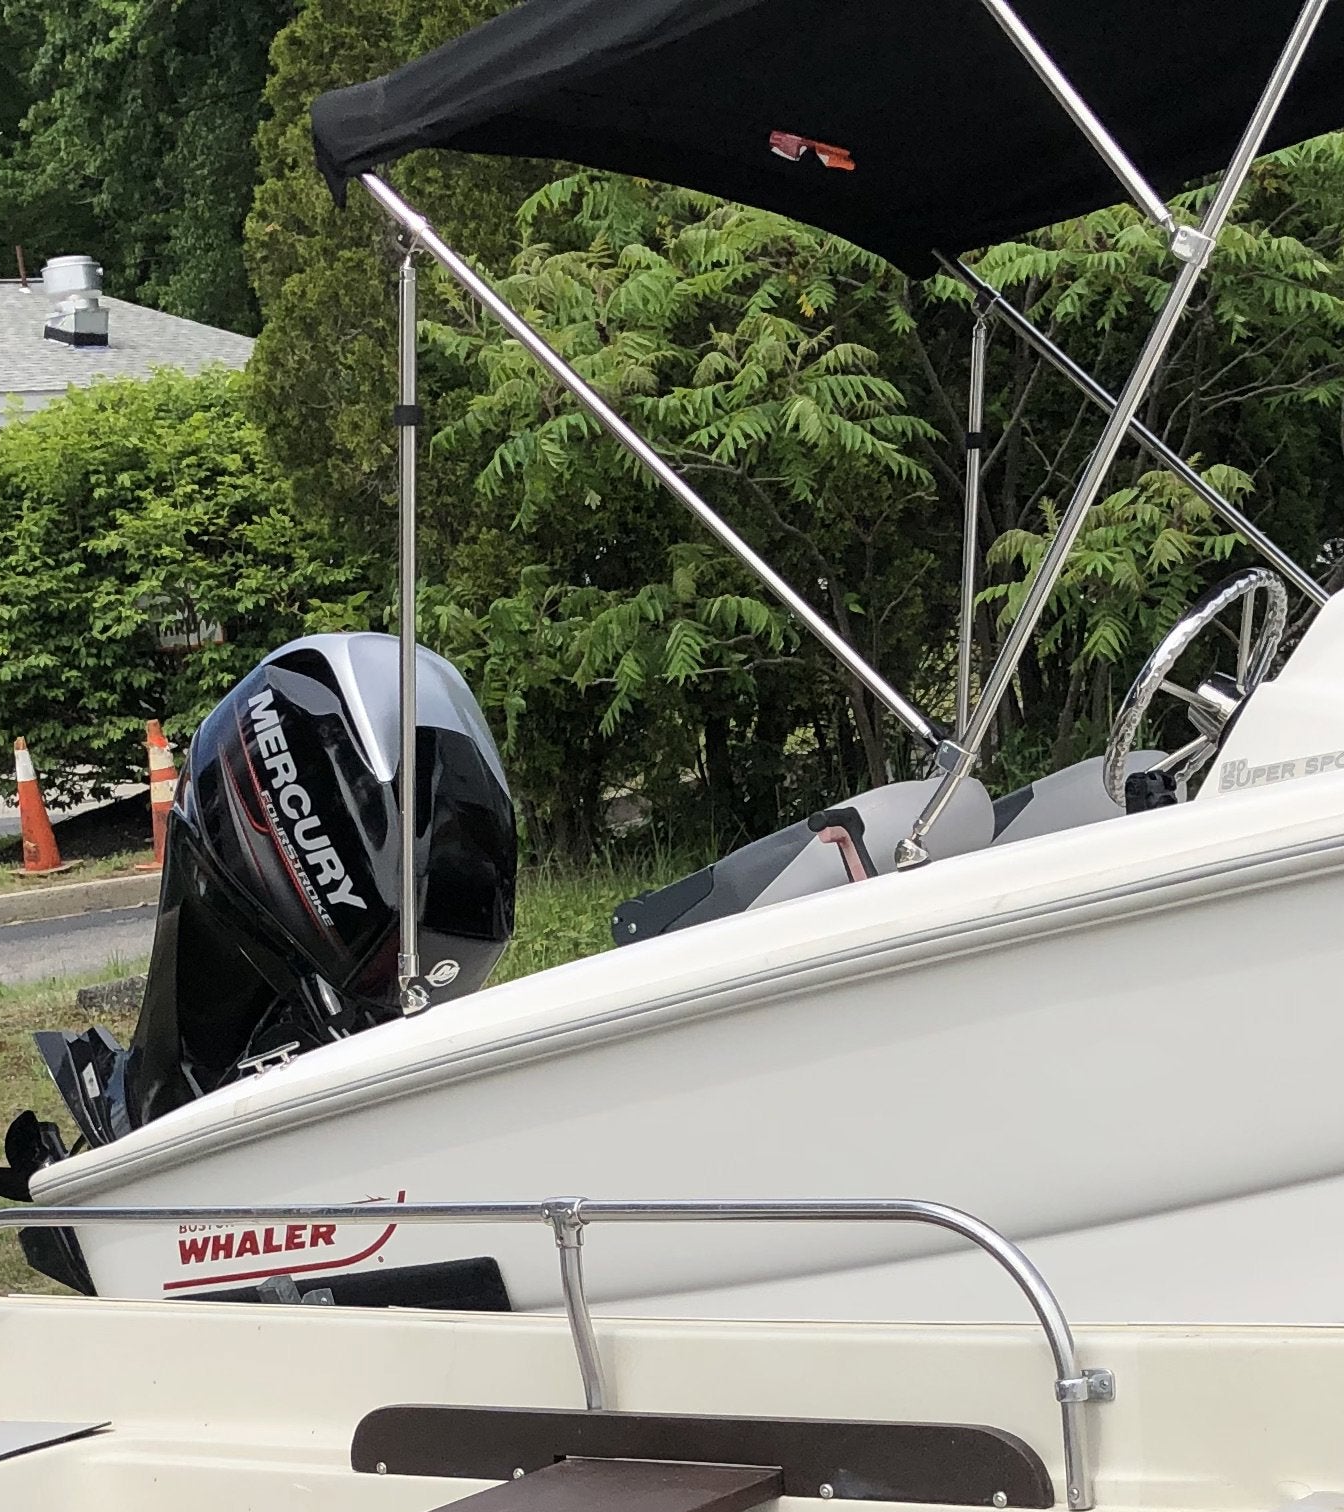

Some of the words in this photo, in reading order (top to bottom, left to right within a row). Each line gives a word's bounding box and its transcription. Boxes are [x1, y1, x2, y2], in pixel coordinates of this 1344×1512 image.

[248, 688, 368, 910] MERCURY
[1221, 761, 1296, 790] SUPER
[260, 789, 335, 928] FOURSTROKE
[178, 1224, 337, 1265] WHALER
